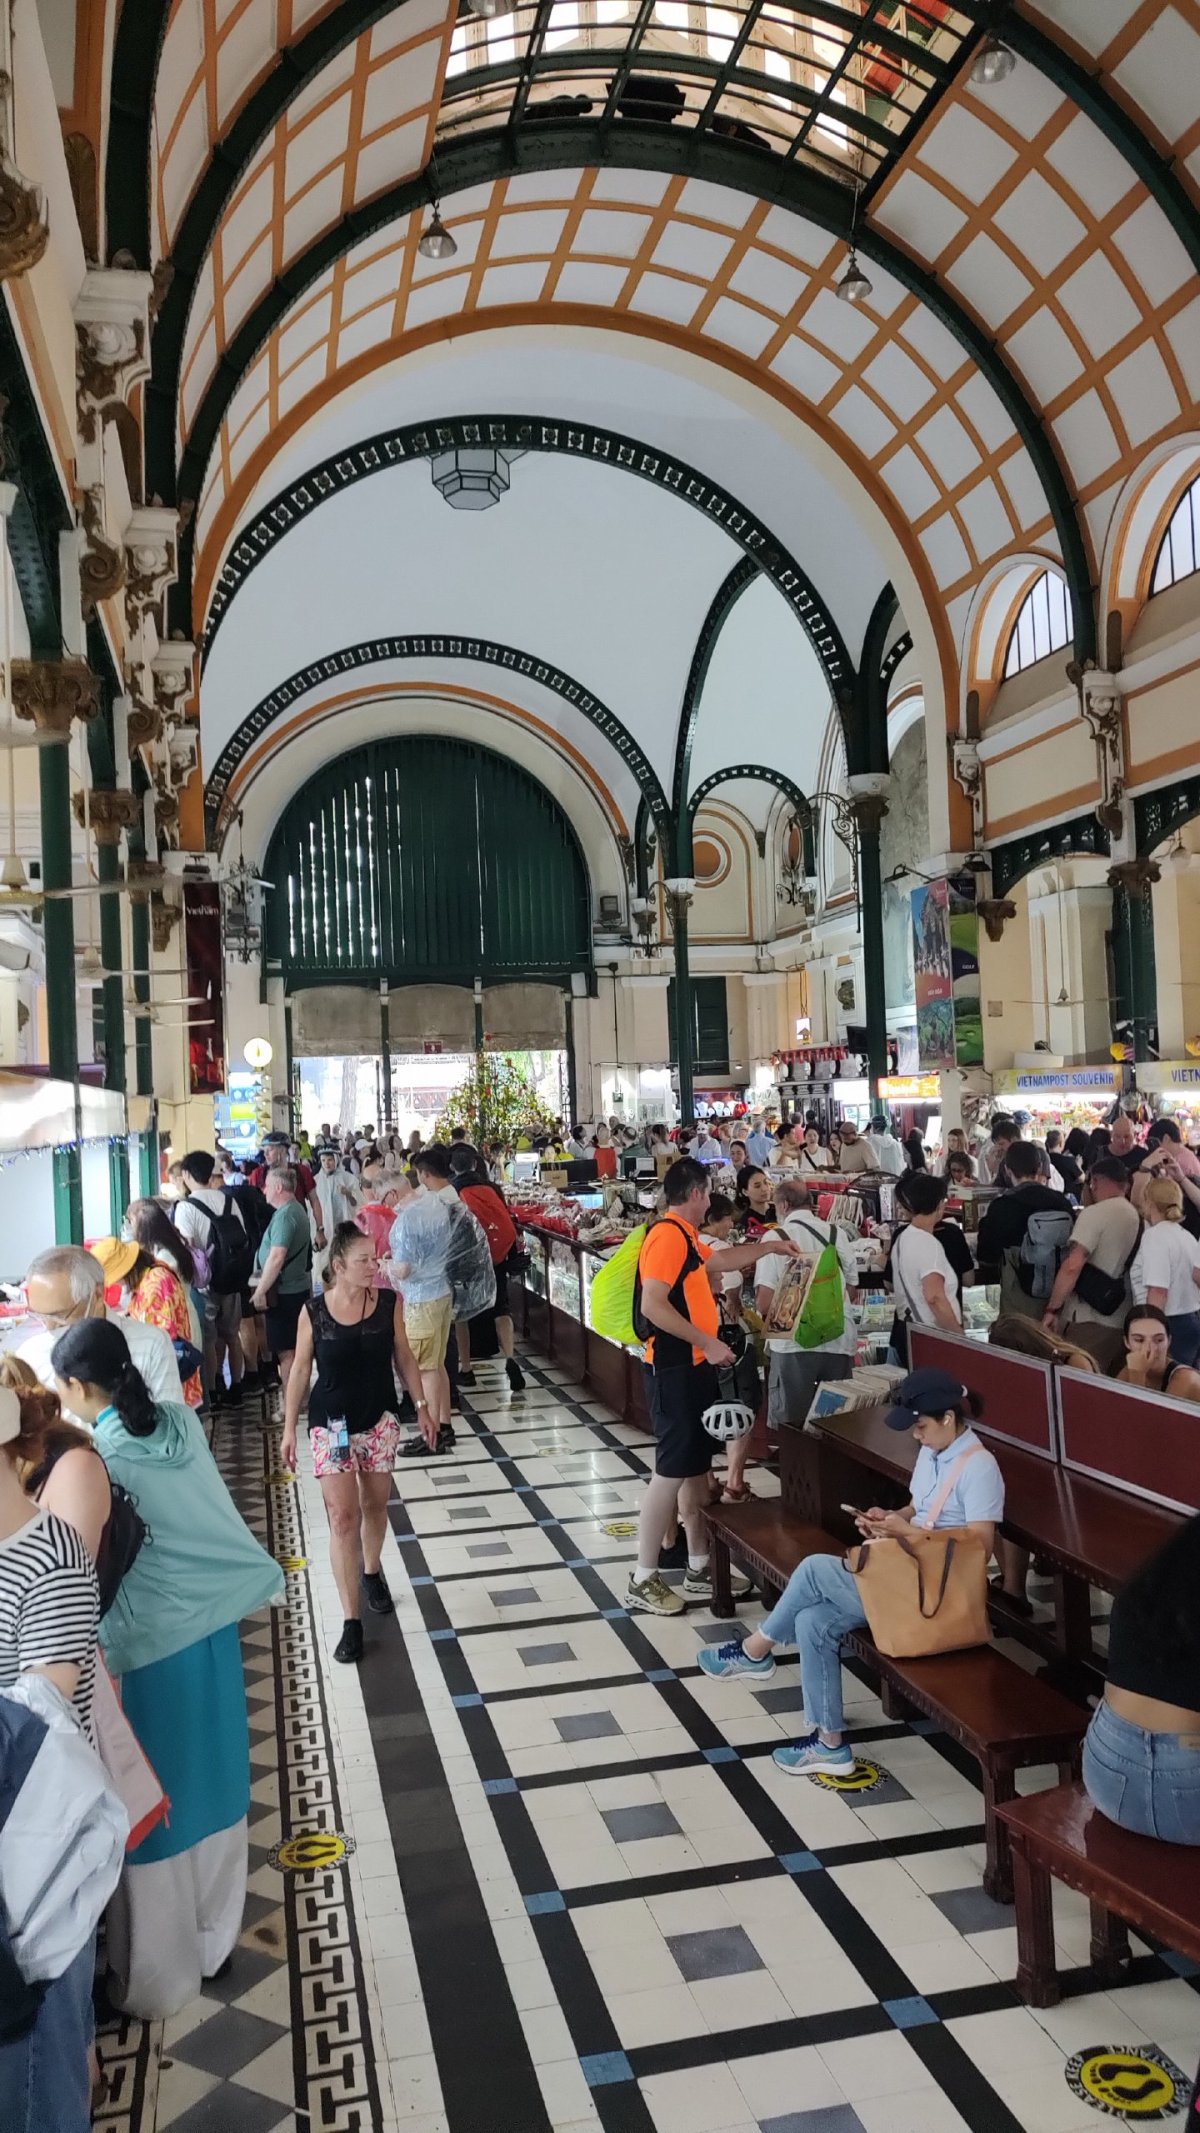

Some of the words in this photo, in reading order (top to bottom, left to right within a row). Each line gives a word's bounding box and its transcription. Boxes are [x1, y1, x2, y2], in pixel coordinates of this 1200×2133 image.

[1016, 1073, 1069, 1088] VIETNAMPOST
[1072, 1070, 1114, 1086] SOUVENIR
[1064, 2054, 1085, 2078] KEEP
[1069, 2079, 1126, 2121] PLEASE
